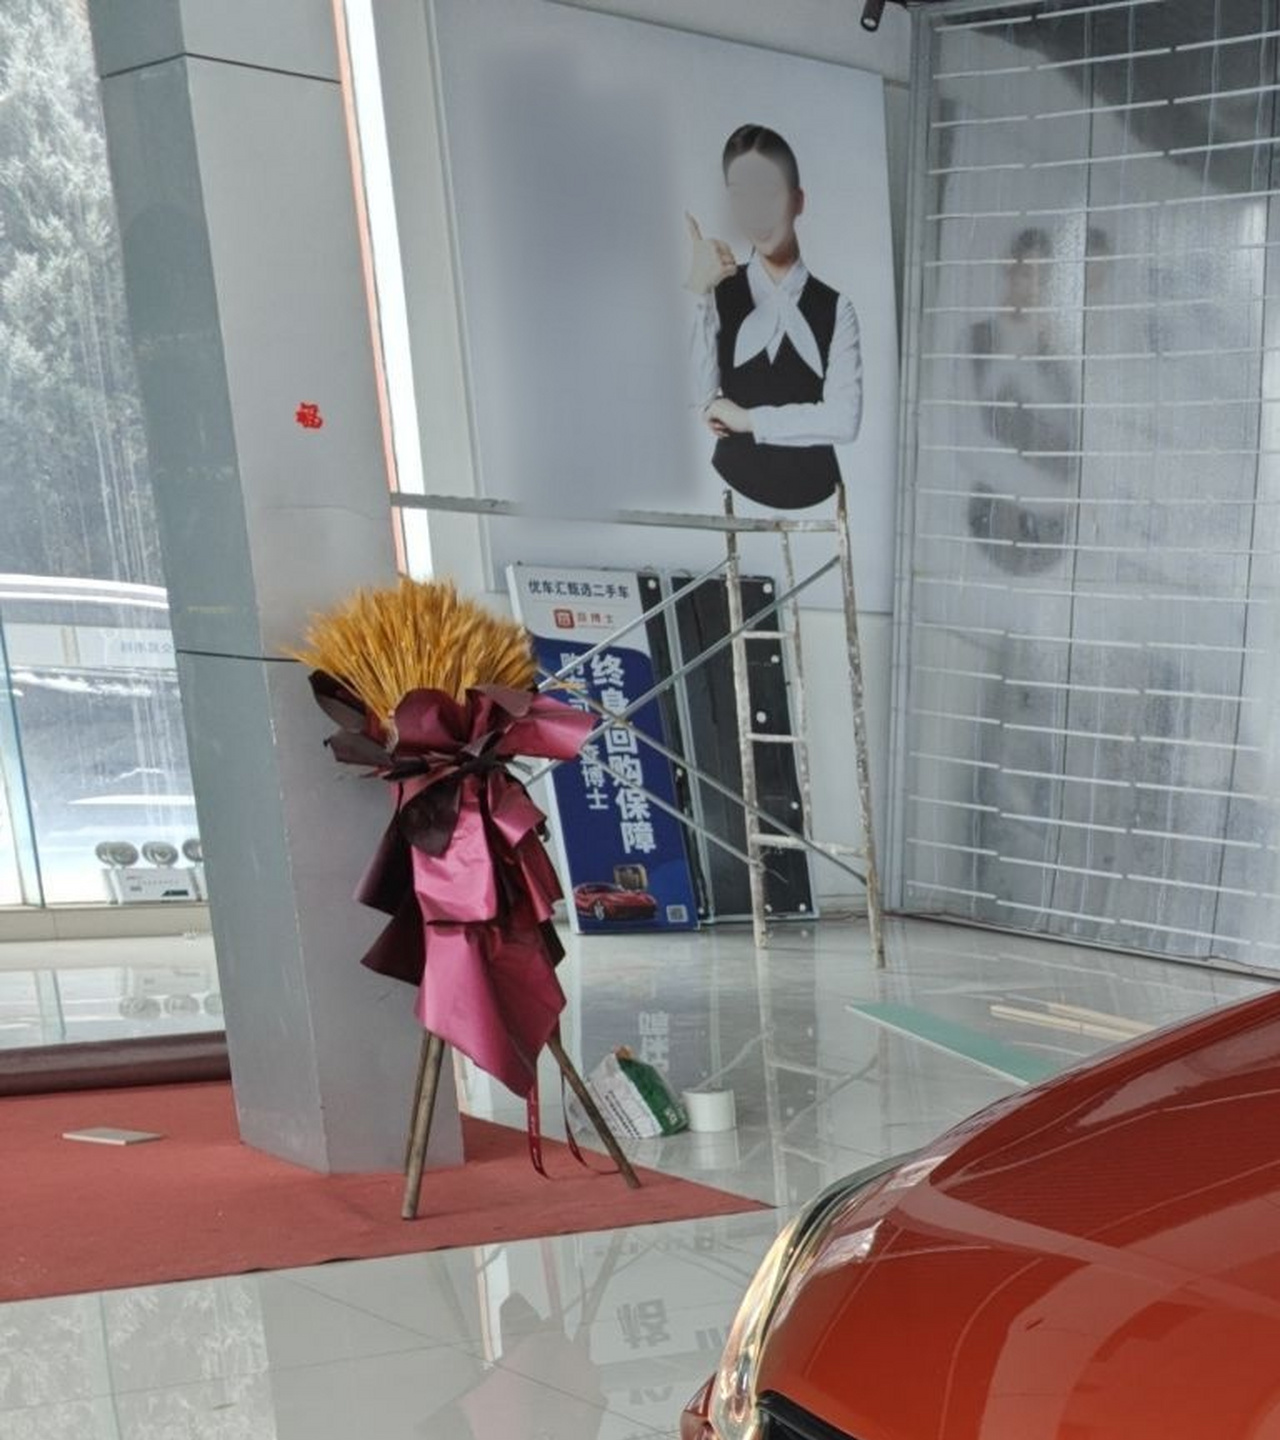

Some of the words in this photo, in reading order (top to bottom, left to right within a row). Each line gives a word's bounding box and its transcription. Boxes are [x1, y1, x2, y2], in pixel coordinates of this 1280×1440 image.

[591, 653, 656, 854] 终身回购保障
